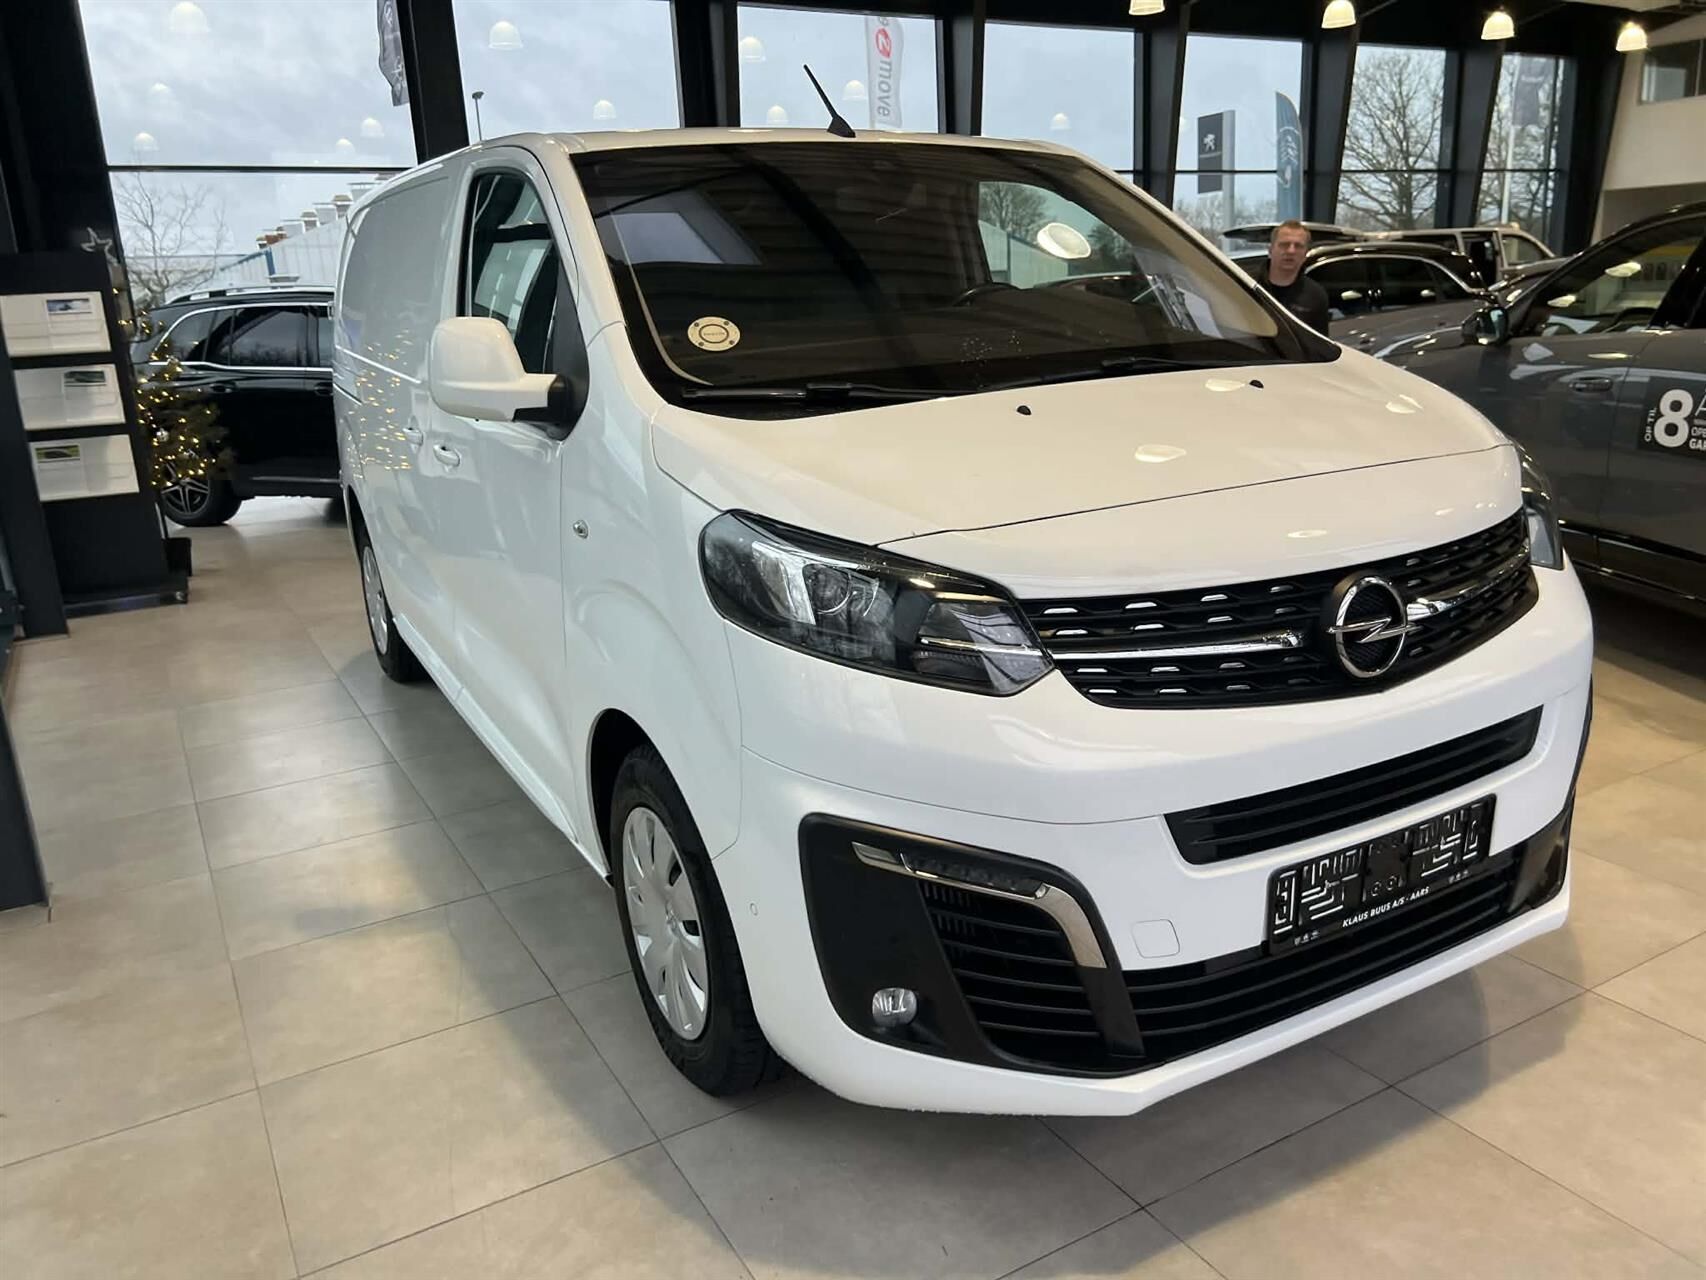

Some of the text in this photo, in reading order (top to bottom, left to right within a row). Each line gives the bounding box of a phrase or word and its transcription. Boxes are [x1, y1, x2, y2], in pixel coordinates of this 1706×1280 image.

[1653, 388, 1694, 448] 8
[1342, 911, 1369, 928] KLAUS
[1370, 902, 1392, 917] BUUS
[1409, 886, 1430, 901] AARS
